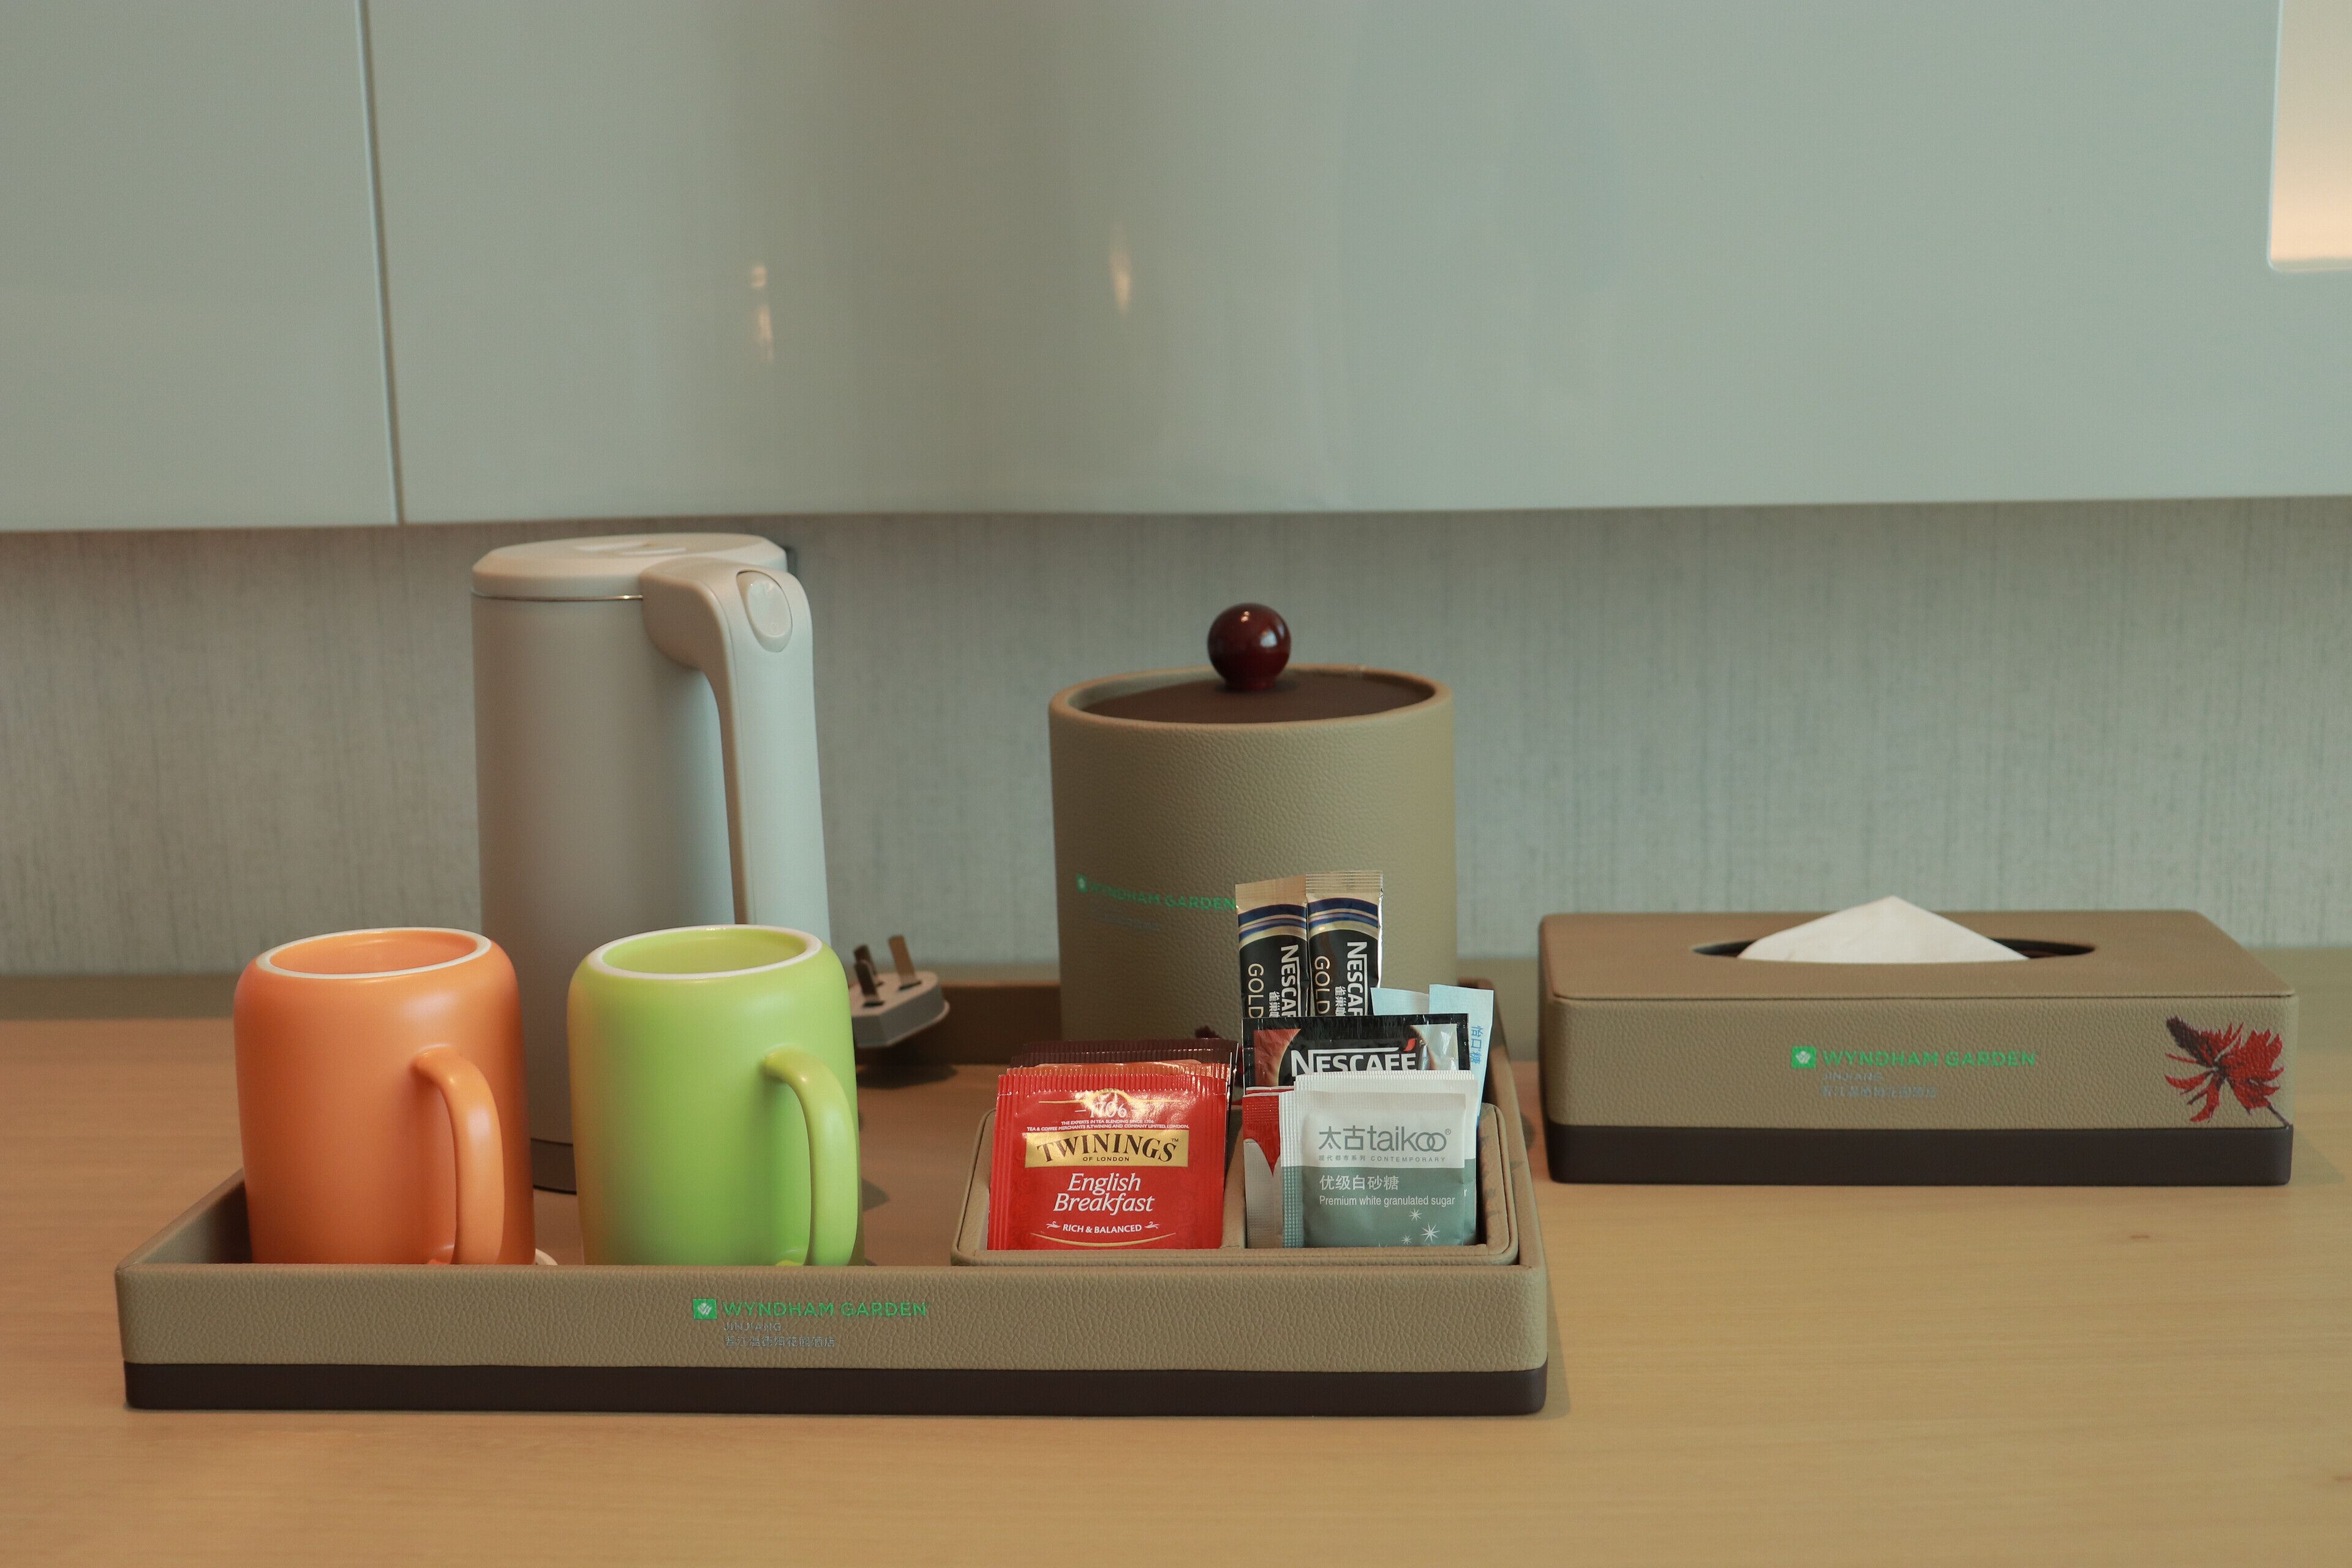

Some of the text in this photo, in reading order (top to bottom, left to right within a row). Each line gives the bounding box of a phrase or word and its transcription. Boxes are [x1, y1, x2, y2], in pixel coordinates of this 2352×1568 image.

[1164, 894, 1235, 911] GARDEN
[1314, 956, 1330, 1014] GOLD
[1347, 941, 1368, 1016] NESCAF
[1248, 963, 1264, 1019] GOLD
[1335, 986, 1347, 1017] 雀巢咖
[1822, 1050, 2036, 1068] WYNDHAM GARDEN
[1037, 1133, 1177, 1163] TWININGS
[1068, 1173, 1141, 1195] English
[1319, 1175, 1399, 1191] 优级白砂糖
[1053, 1193, 1155, 1216] Breakfast
[1319, 1195, 1455, 1208] Premium white granulated sugar
[1062, 1224, 1084, 1232] RICH
[1094, 1224, 1142, 1234] BALANCED
[722, 1301, 927, 1317] WYNDHAM GARDEN
[724, 1322, 782, 1332] JINJIANG
